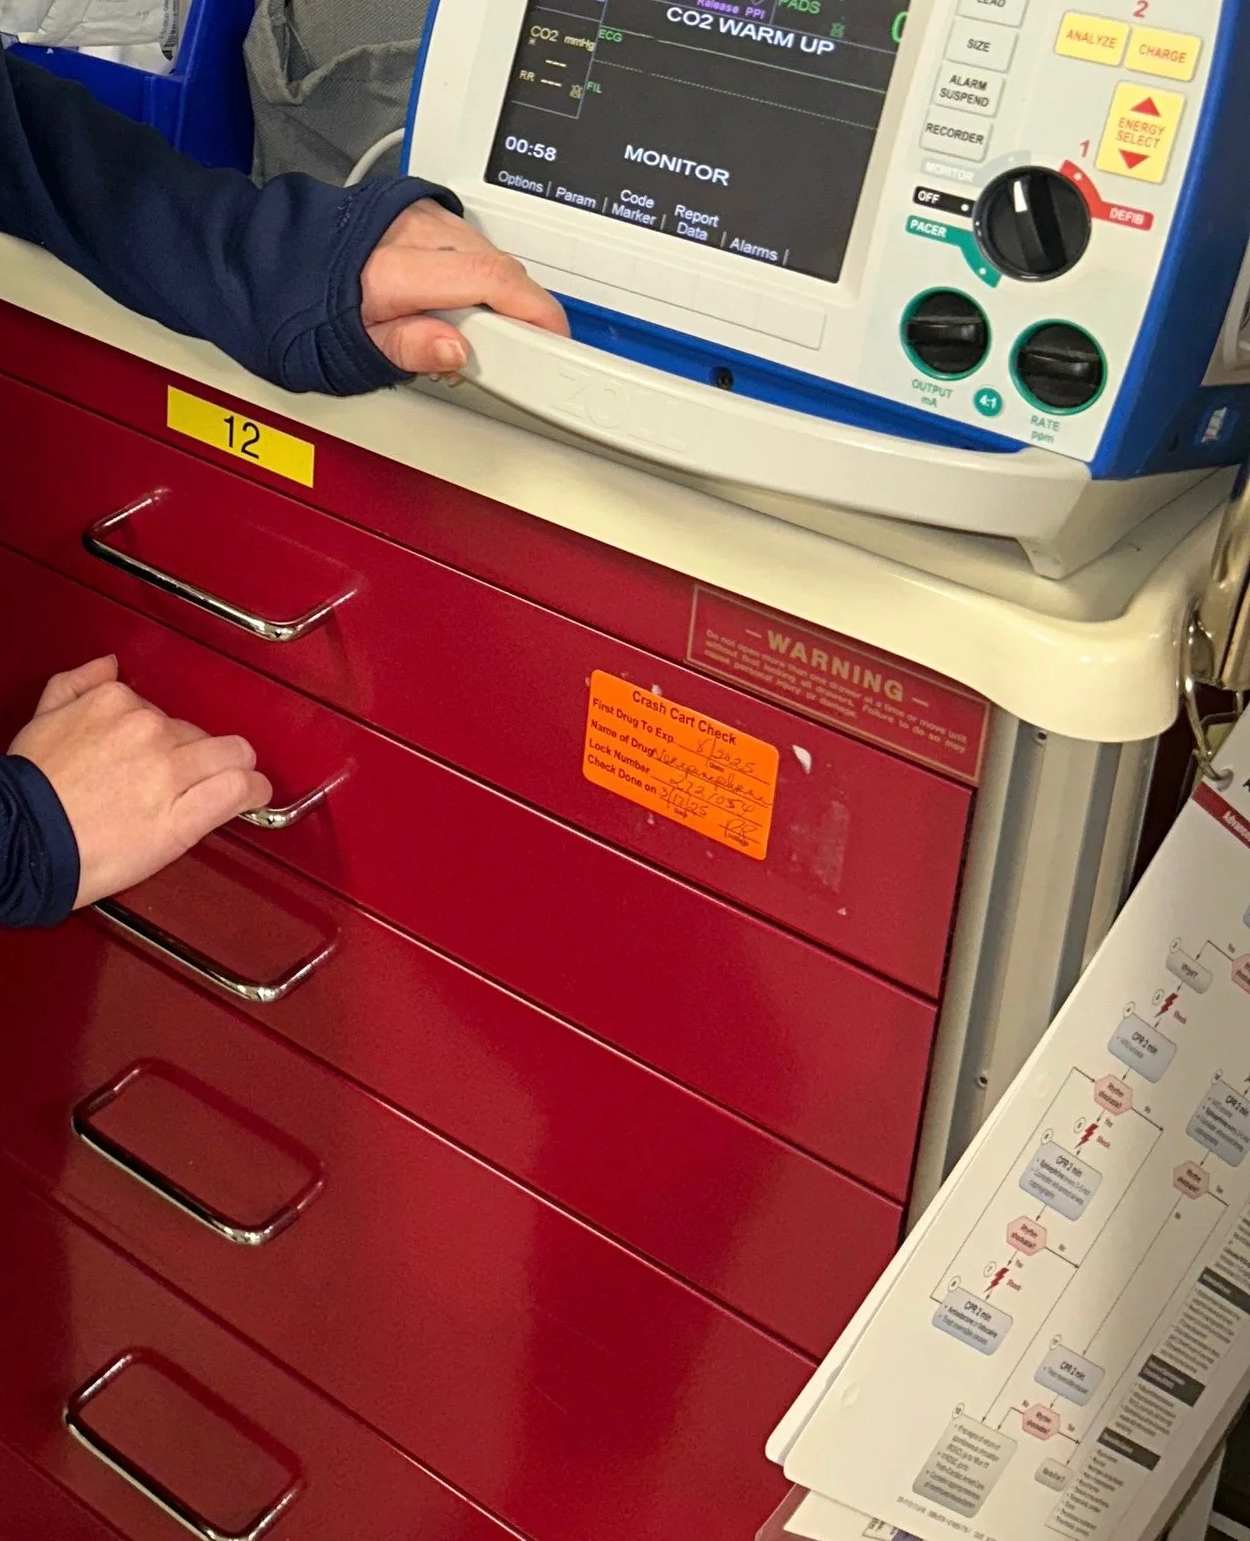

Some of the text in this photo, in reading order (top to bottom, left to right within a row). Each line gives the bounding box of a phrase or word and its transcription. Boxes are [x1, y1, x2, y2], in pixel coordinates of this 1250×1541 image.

[745, 6, 765, 20] PPI
[1133, 0, 1149, 18] 2
[530, 25, 595, 52] CO2 mmHg
[598, 27, 623, 43] ECG
[666, 7, 836, 56] CO2 WARM UP
[1065, 28, 1118, 50] ANALYZE
[967, 38, 991, 53] SIZE
[1138, 43, 1188, 64] CHARGE
[519, 69, 535, 83] RR
[949, 73, 988, 92] ALARM
[586, 81, 602, 94] FIL
[939, 87, 990, 108] SUSPEND
[925, 122, 985, 146] RECORDER
[1118, 117, 1166, 135] ENERGY
[504, 136, 557, 161] 00:58
[1079, 139, 1091, 158] 1
[1116, 129, 1161, 149] SELECT
[624, 144, 730, 186] MONITOR
[925, 162, 975, 183] MONITOR
[498, 171, 544, 193] Options
[555, 186, 597, 209] Param
[620, 189, 655, 209] Code
[917, 190, 940, 204] OFF
[611, 202, 657, 226] Marker
[674, 204, 720, 228] Report
[1108, 207, 1146, 225] DEFIB
[677, 222, 709, 242] Data
[910, 217, 947, 239] PACER
[729, 237, 779, 261] Alarms
[911, 379, 953, 399] OUTPUT
[920, 395, 938, 409] mA
[978, 394, 998, 409] 4:1
[1030, 415, 1061, 432] RATE
[223, 414, 262, 460] 12
[1030, 429, 1055, 444] ppm
[767, 629, 904, 702] WARNING
[592, 698, 674, 743] First Drug To Exp
[633, 691, 736, 745] Crash Cart Check
[590, 720, 654, 756] Name of Drug
[589, 739, 650, 775] Lock Number
[587, 754, 657, 794] Check Done on
